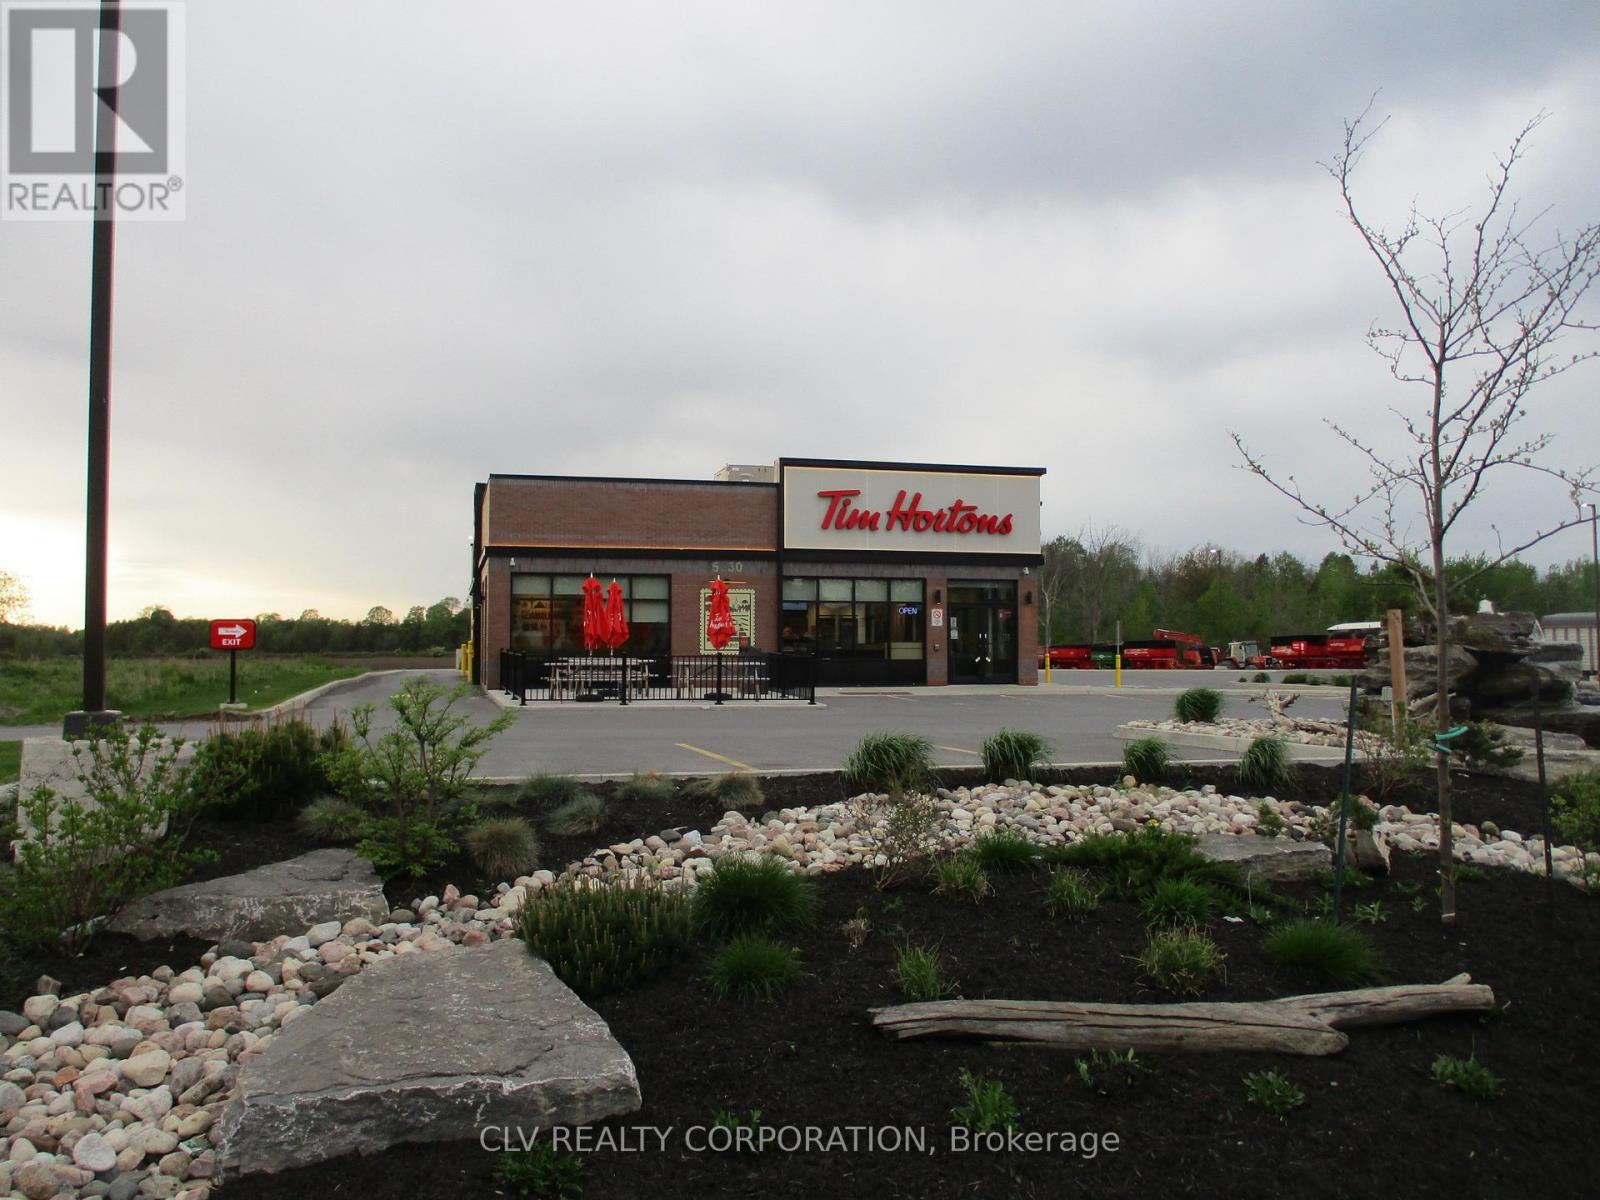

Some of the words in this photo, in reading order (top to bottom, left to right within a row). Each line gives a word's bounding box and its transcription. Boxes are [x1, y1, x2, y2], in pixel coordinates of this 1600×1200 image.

[817, 490, 880, 531] Tim
[886, 490, 1013, 535] Hortons
[898, 607, 918, 615] OPEN
[222, 638, 241, 646] EXIT
